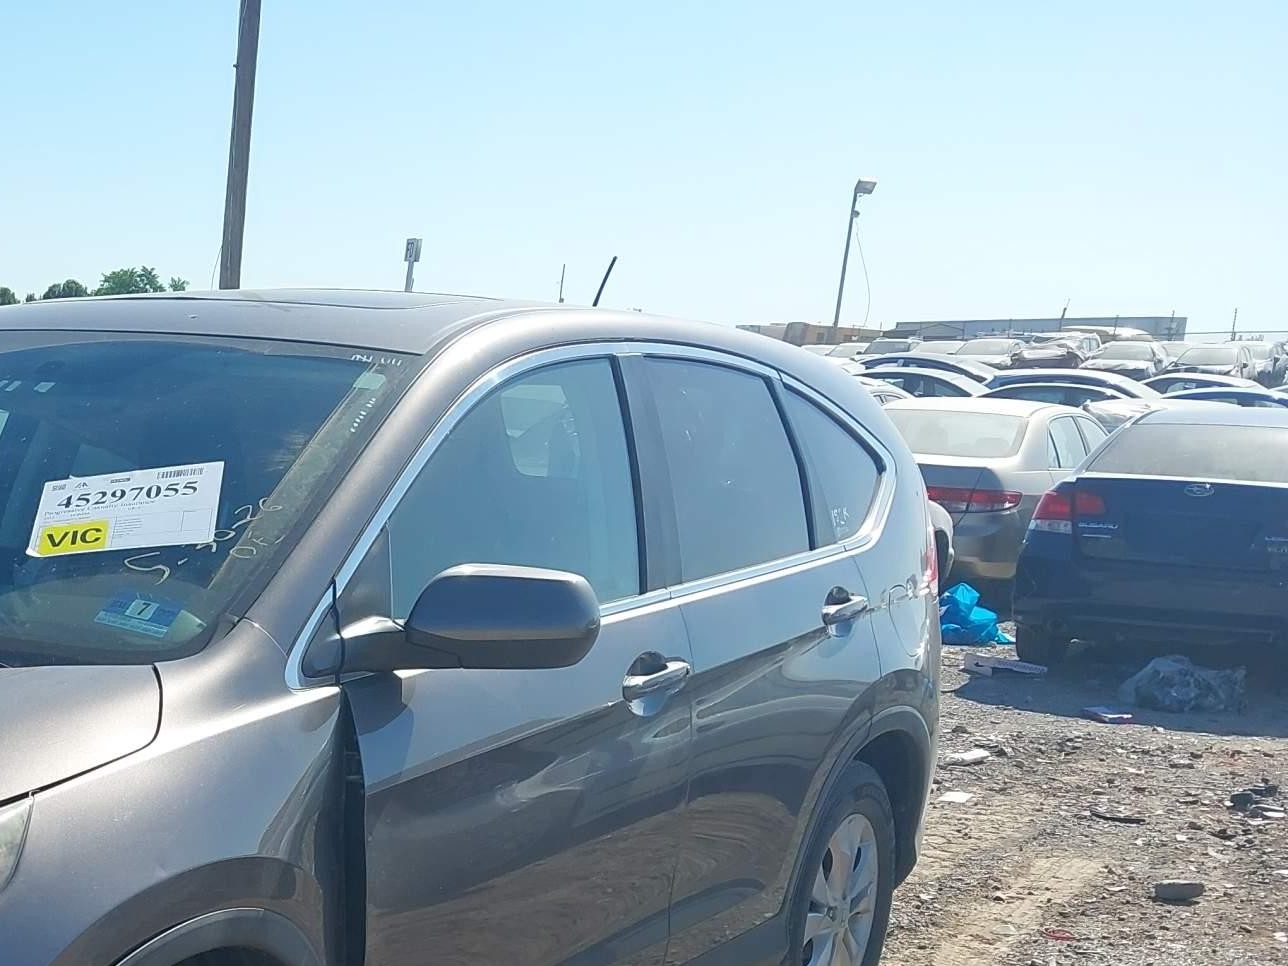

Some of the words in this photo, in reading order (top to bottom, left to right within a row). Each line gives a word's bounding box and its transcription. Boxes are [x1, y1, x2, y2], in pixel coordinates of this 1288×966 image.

[56, 480, 199, 509] 45297055
[45, 527, 103, 548] VIC
[136, 602, 152, 616] 7
